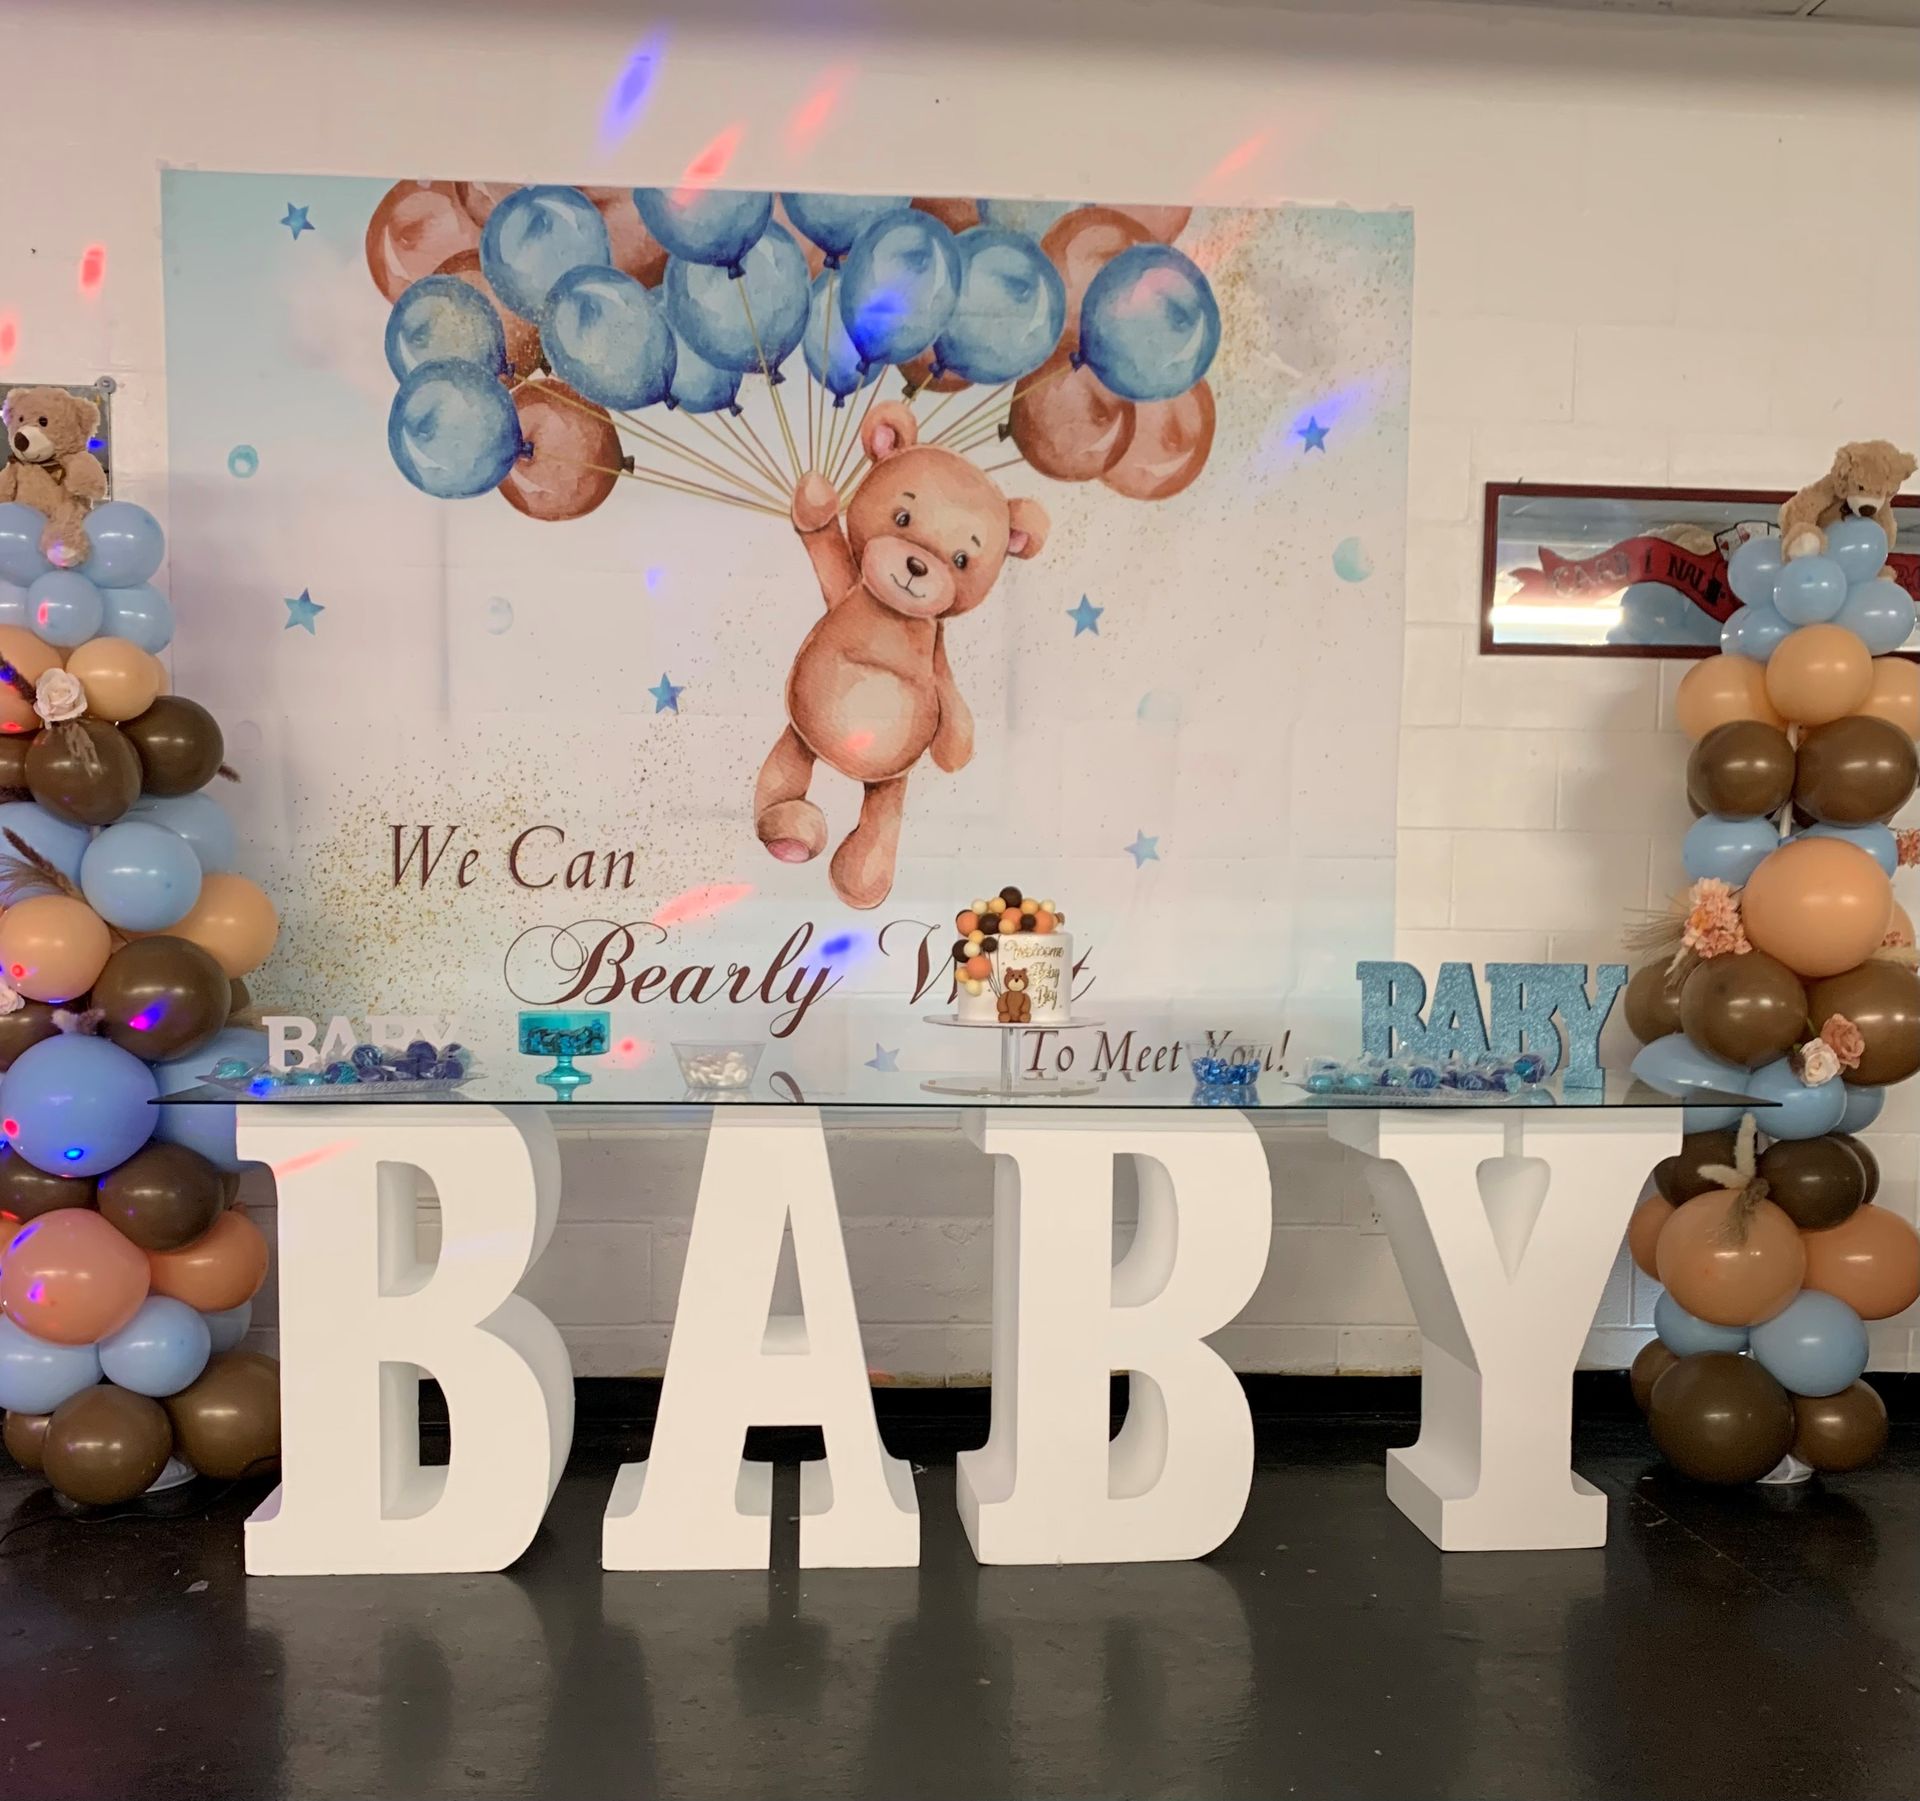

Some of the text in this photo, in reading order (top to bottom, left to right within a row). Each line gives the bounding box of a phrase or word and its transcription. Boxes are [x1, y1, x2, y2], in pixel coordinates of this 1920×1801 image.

[389, 824, 637, 889] We Can
[503, 918, 1098, 1039] Bearly Wt
[1356, 960, 1629, 1089] BABY
[1023, 1030, 1075, 1073] To
[1090, 1030, 1183, 1073] Meet
[238, 1107, 1684, 1576] BABY
